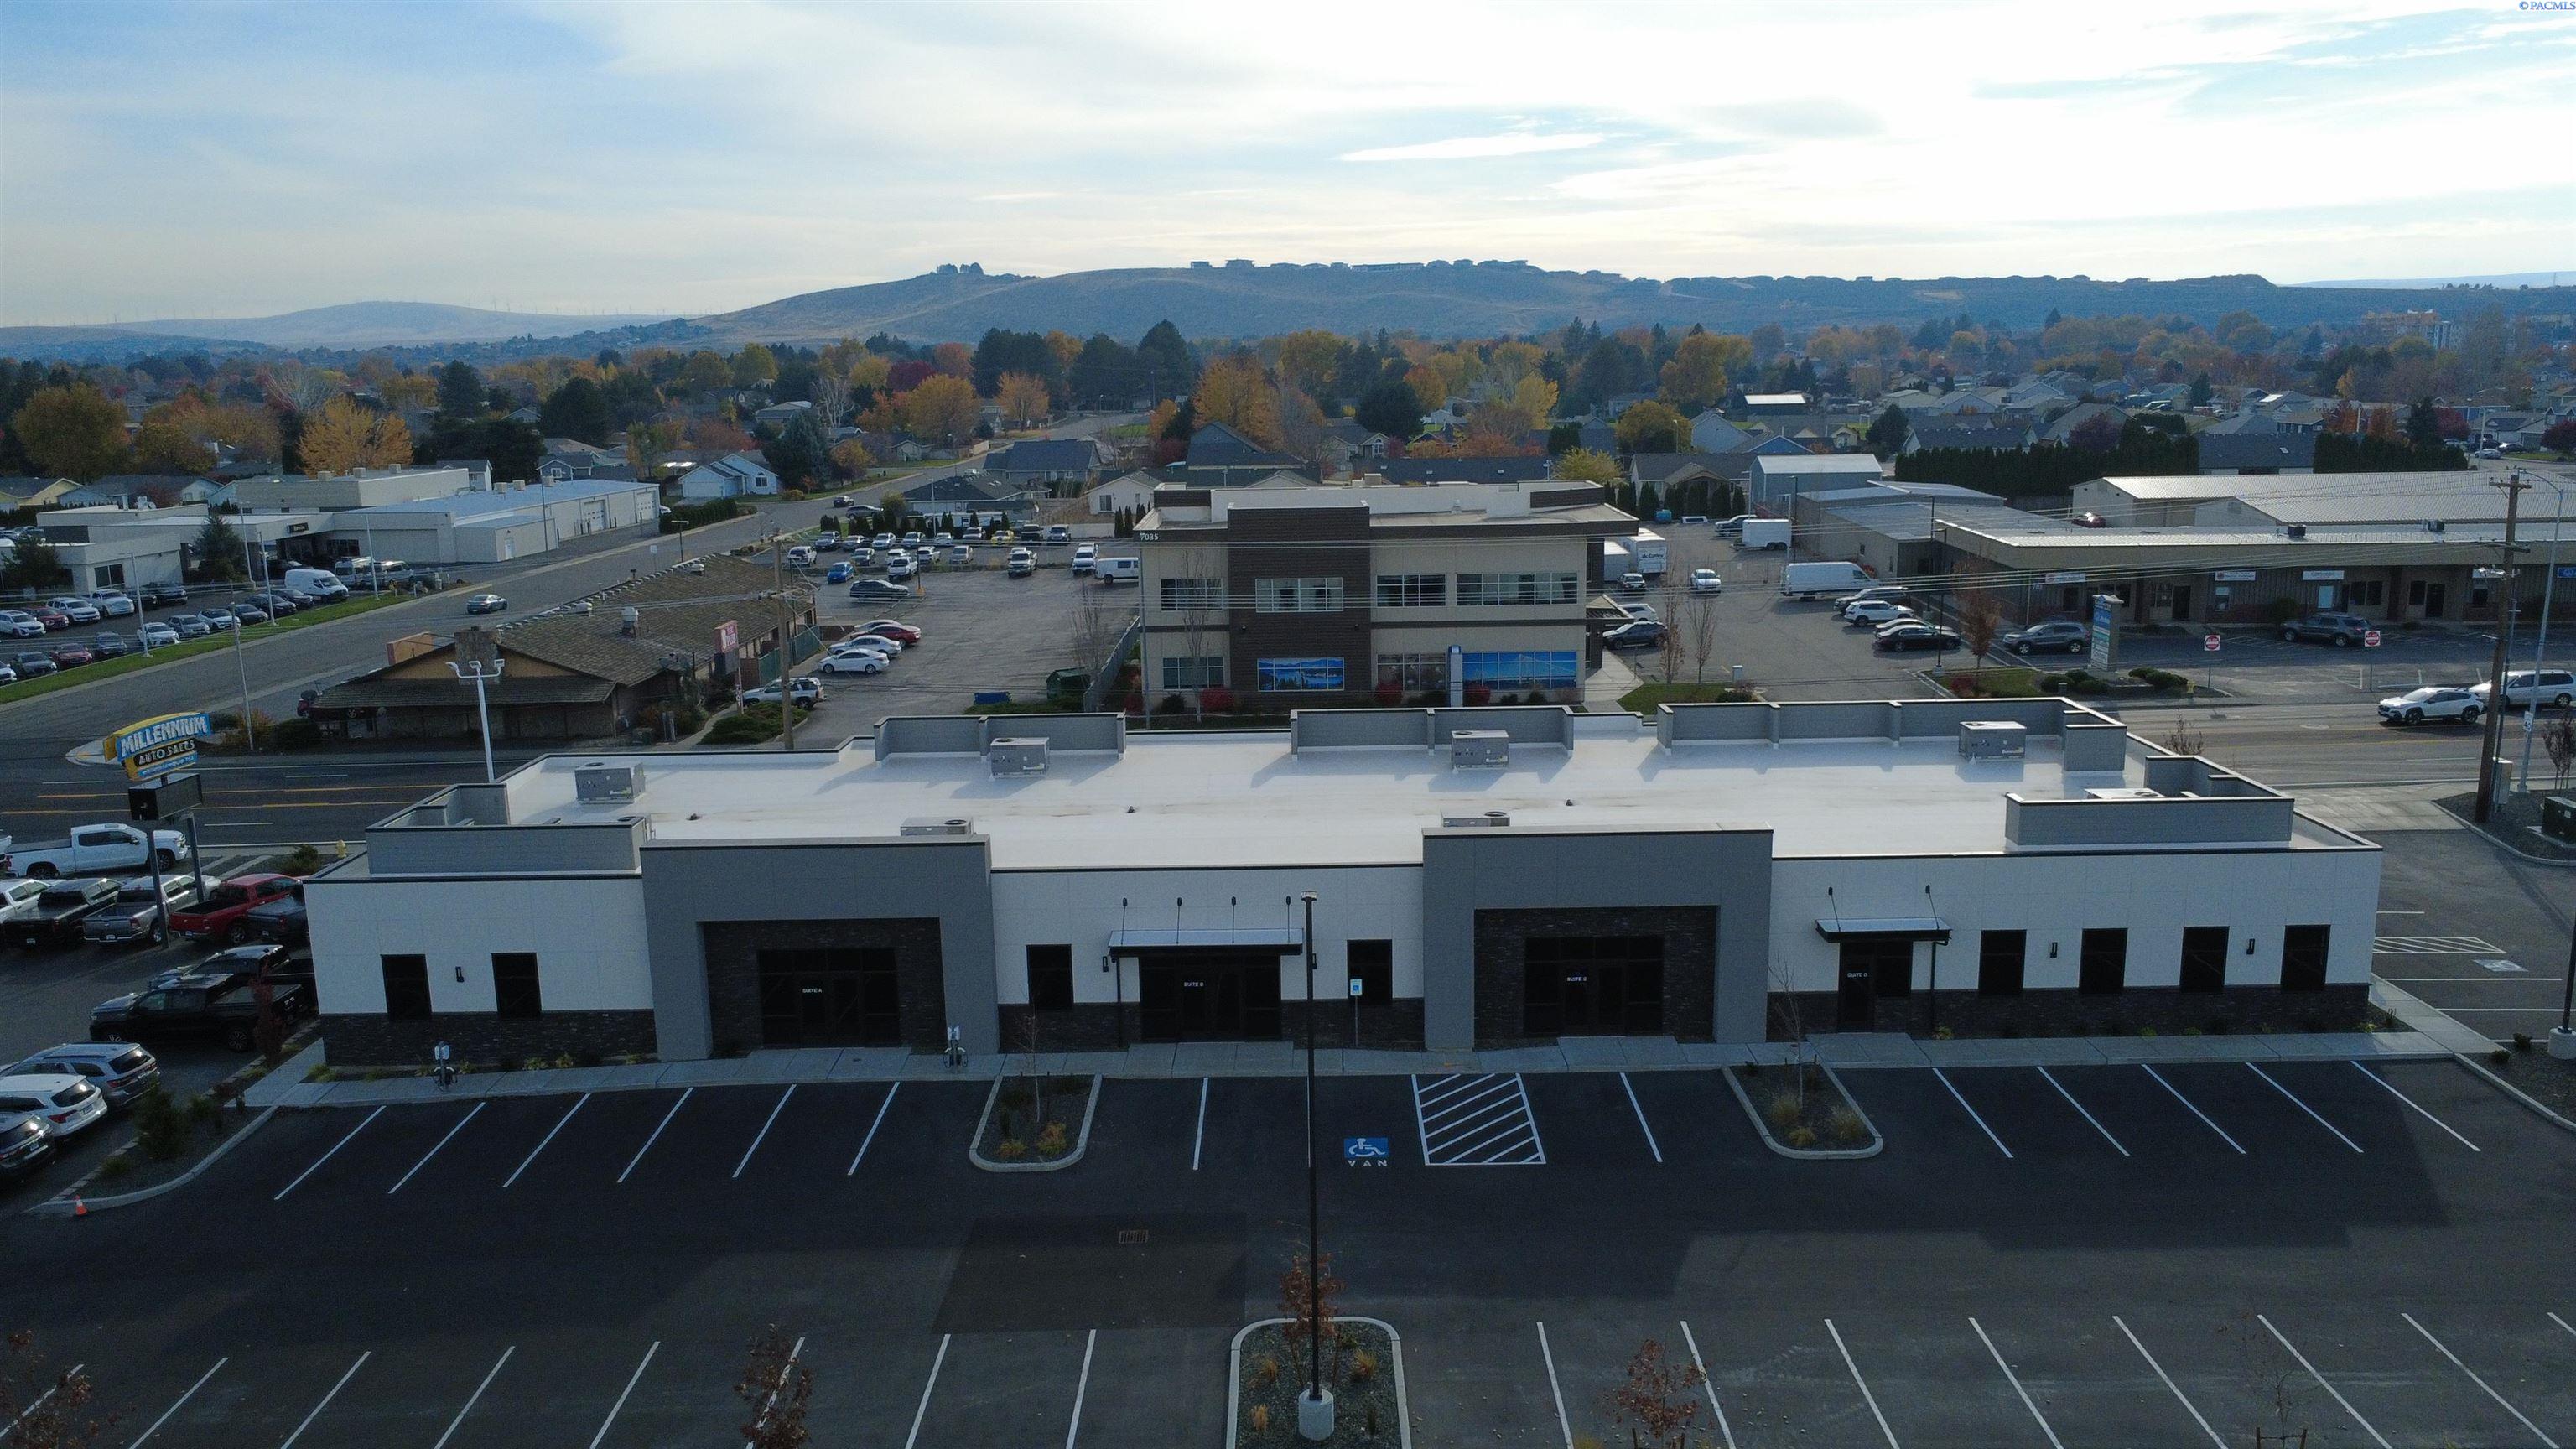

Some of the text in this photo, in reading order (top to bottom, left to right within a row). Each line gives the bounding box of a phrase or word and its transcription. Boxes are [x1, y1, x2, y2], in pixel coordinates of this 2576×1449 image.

[1140, 532, 1159, 541] 7035
[120, 716, 207, 757] MILLENNIUM
[138, 740, 195, 765] AUTO SALES
[1347, 1159, 1388, 1167] VAN
